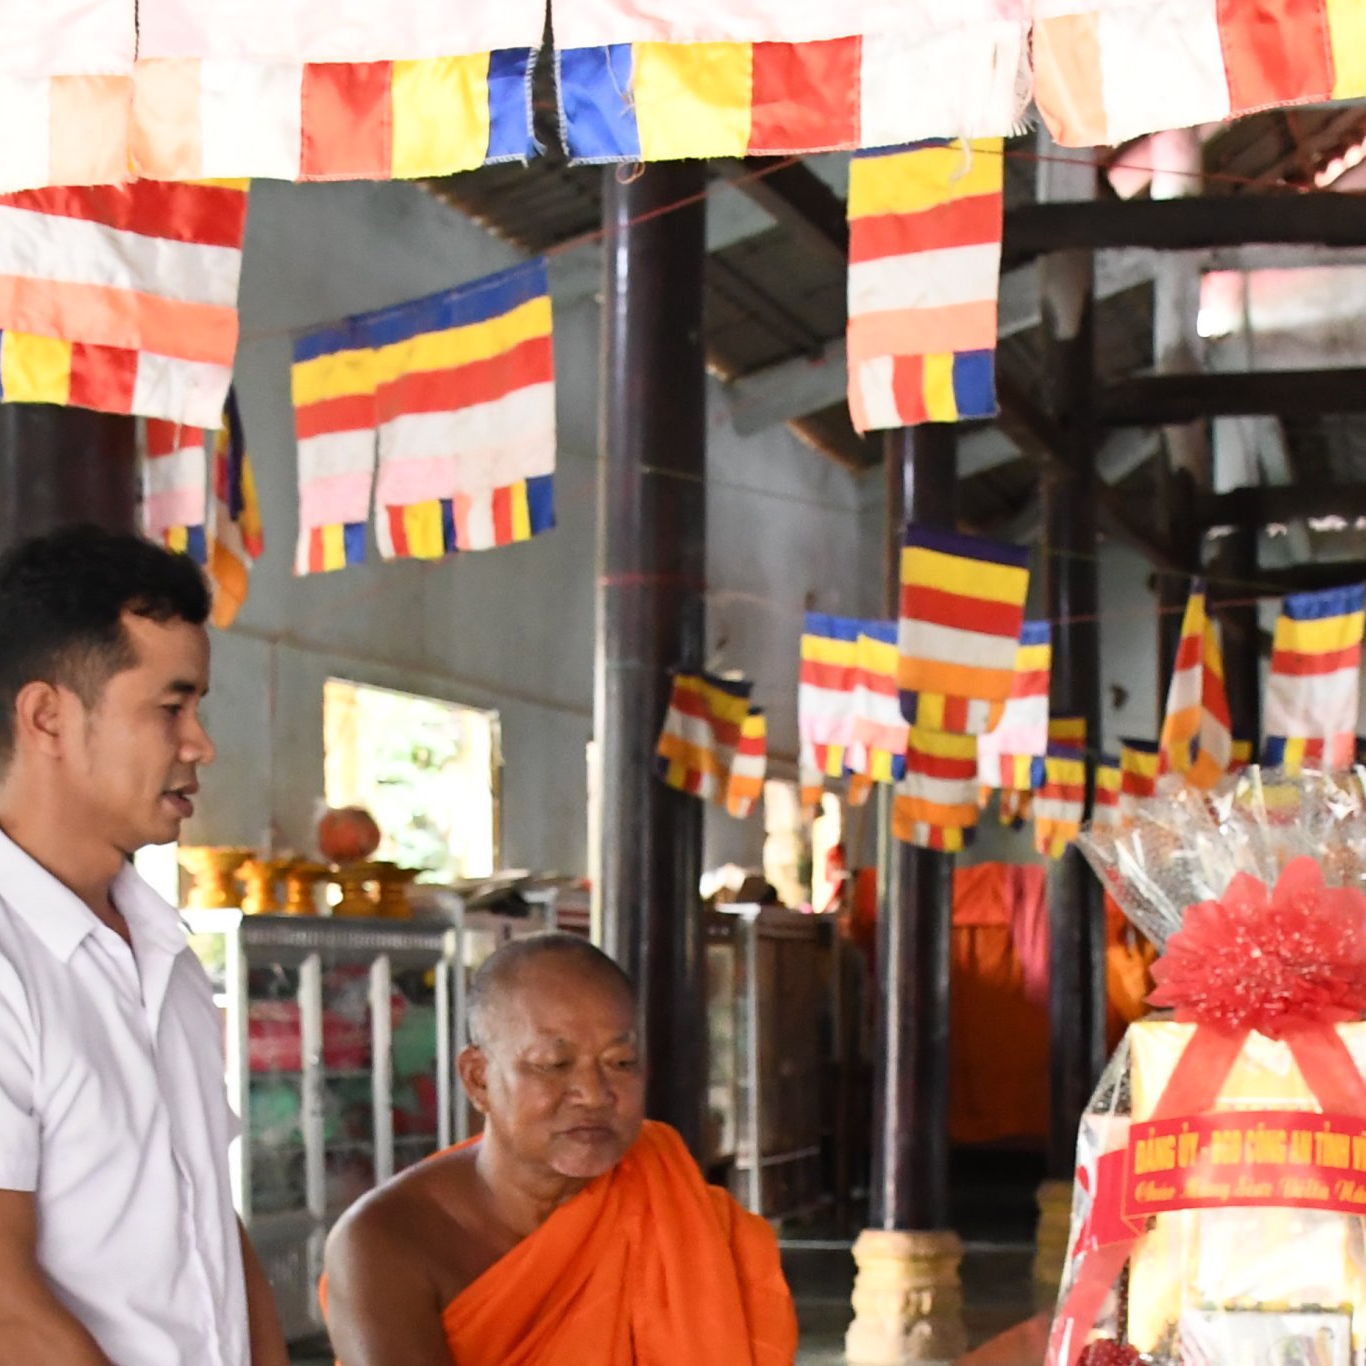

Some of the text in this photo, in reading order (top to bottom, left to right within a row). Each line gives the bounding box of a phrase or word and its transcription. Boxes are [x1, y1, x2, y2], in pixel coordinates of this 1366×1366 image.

[1245, 1122, 1287, 1164] CÔNG
[1290, 1130, 1312, 1165] AN
[1315, 1121, 1350, 1169] TỈNH
